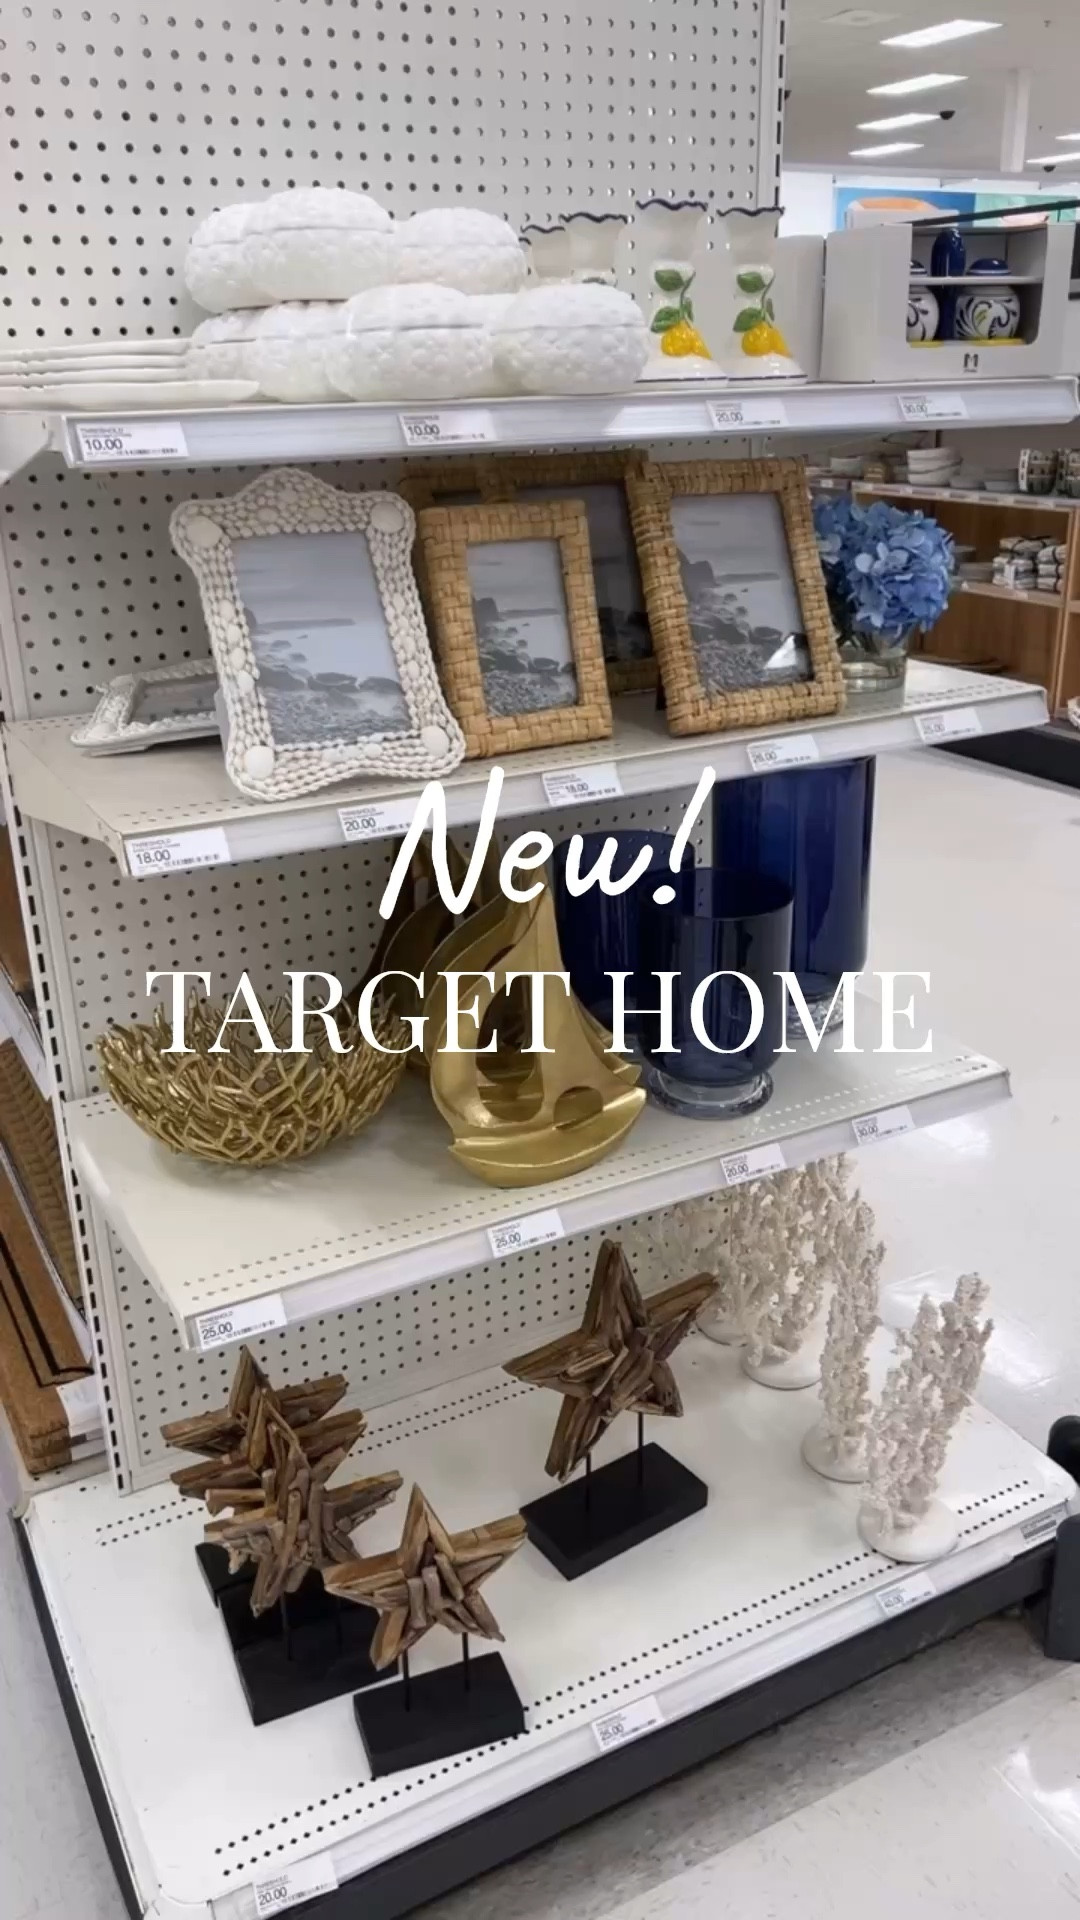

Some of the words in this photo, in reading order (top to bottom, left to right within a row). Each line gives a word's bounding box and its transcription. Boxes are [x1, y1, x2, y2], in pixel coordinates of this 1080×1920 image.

[407, 424, 439, 436] 10.00
[84, 438, 123, 451] 10.00
[344, 817, 376, 832] 20.00
[136, 849, 171, 865] 18.00
[725, 1163, 748, 1178] 20.00
[495, 1232, 521, 1249] 25.00
[202, 1321, 233, 1340] 25.00
[600, 1723, 624, 1741] 25.00
[258, 1886, 288, 1906] 20.00
